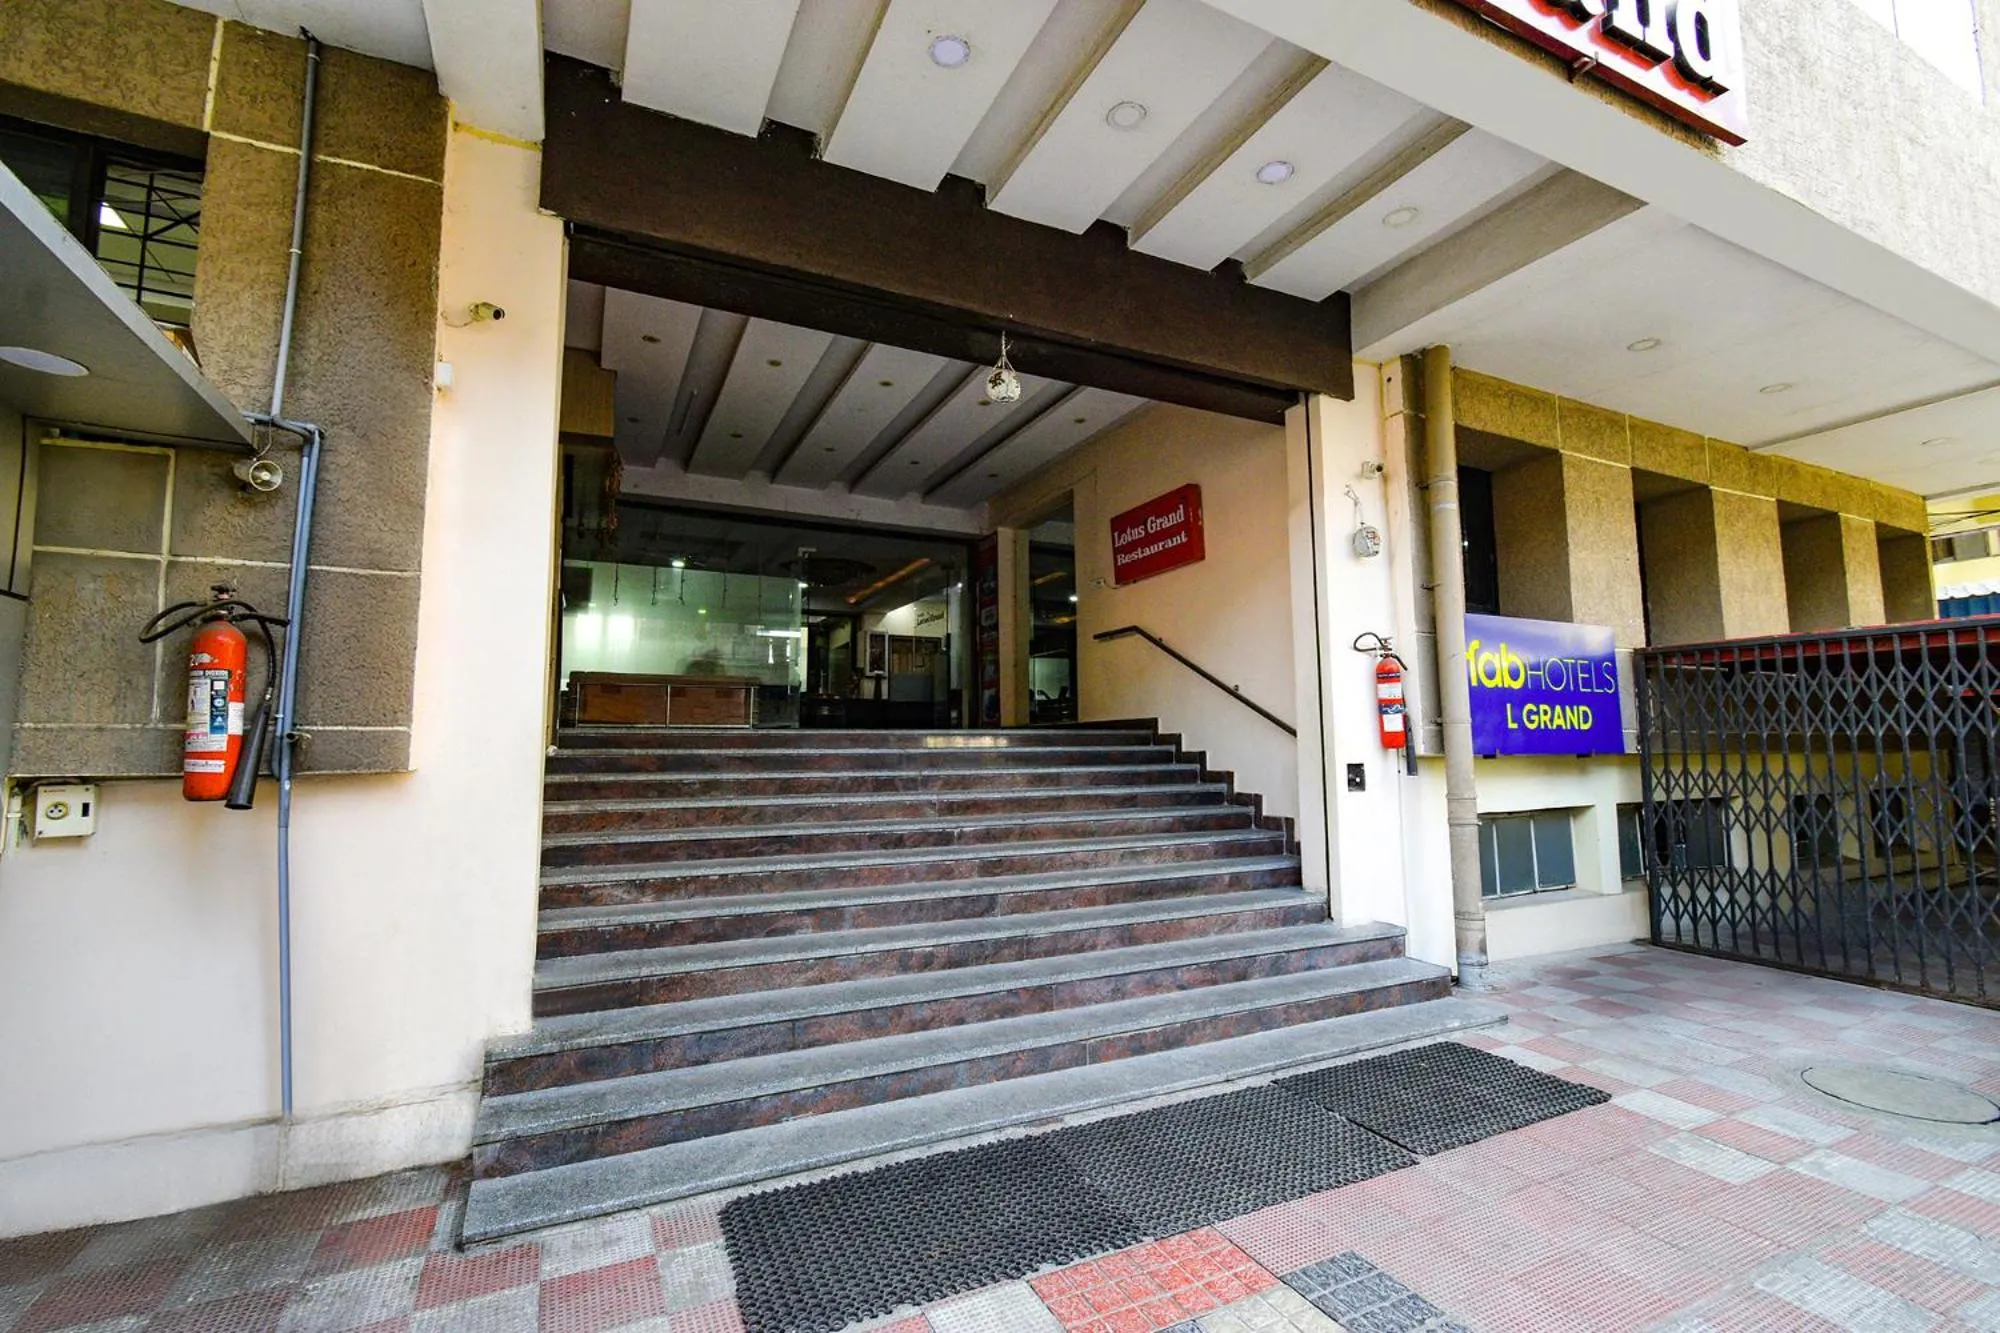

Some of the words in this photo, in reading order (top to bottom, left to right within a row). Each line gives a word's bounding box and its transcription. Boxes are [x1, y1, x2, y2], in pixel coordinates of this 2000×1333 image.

[1530, 0, 1730, 102] nd
[1114, 524, 1145, 548] Lotus
[1147, 504, 1185, 534] Grand
[1116, 530, 1188, 566] Restaurant
[1506, 703, 1518, 729] L
[1522, 703, 1594, 731] GRAND
